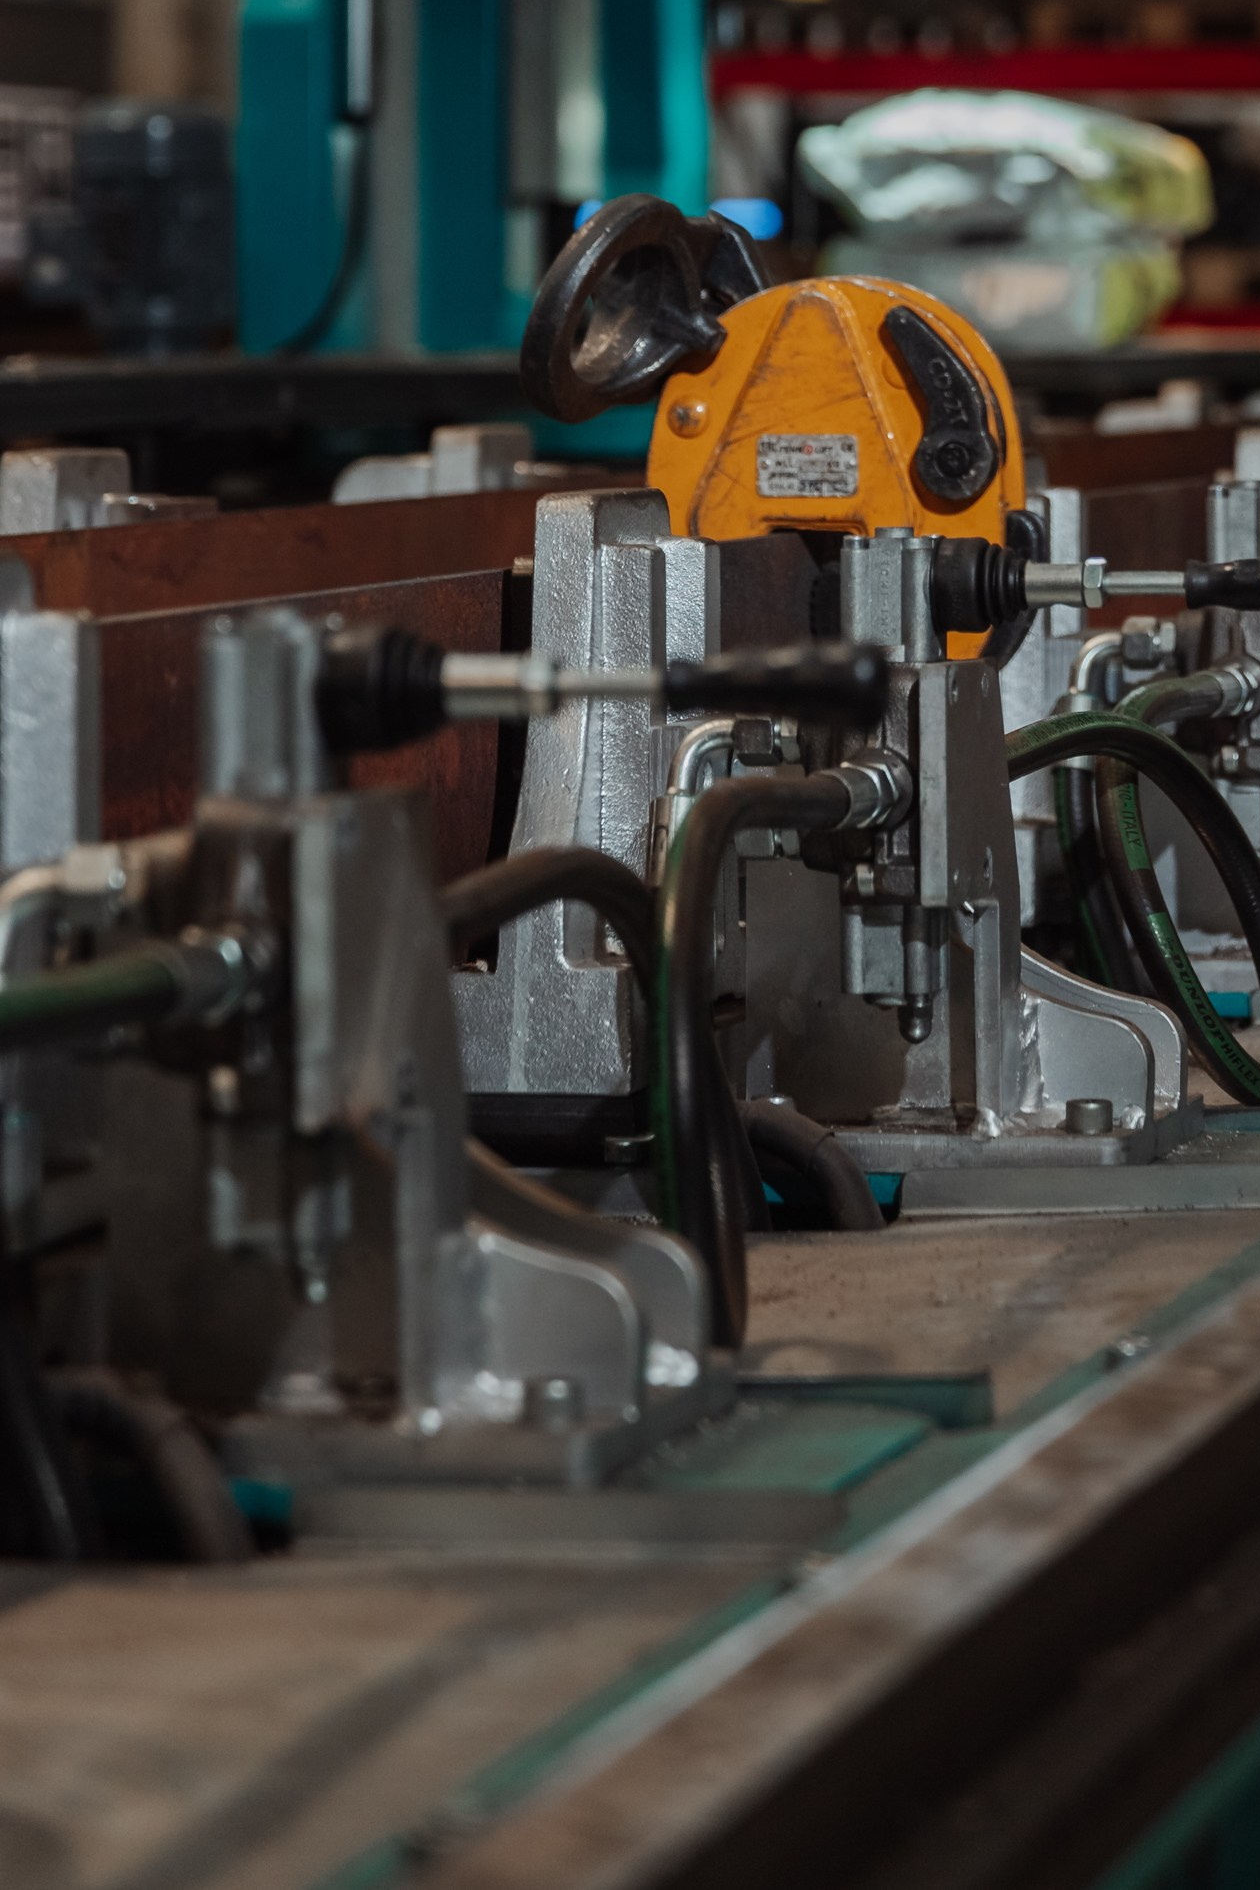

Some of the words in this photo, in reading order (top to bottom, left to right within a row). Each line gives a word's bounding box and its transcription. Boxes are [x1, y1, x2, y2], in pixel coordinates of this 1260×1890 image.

[1121, 811, 1142, 847] ITALY
[1173, 954, 1225, 1043] DUNLOP
[1221, 1042, 1260, 1087] HIFLEX
